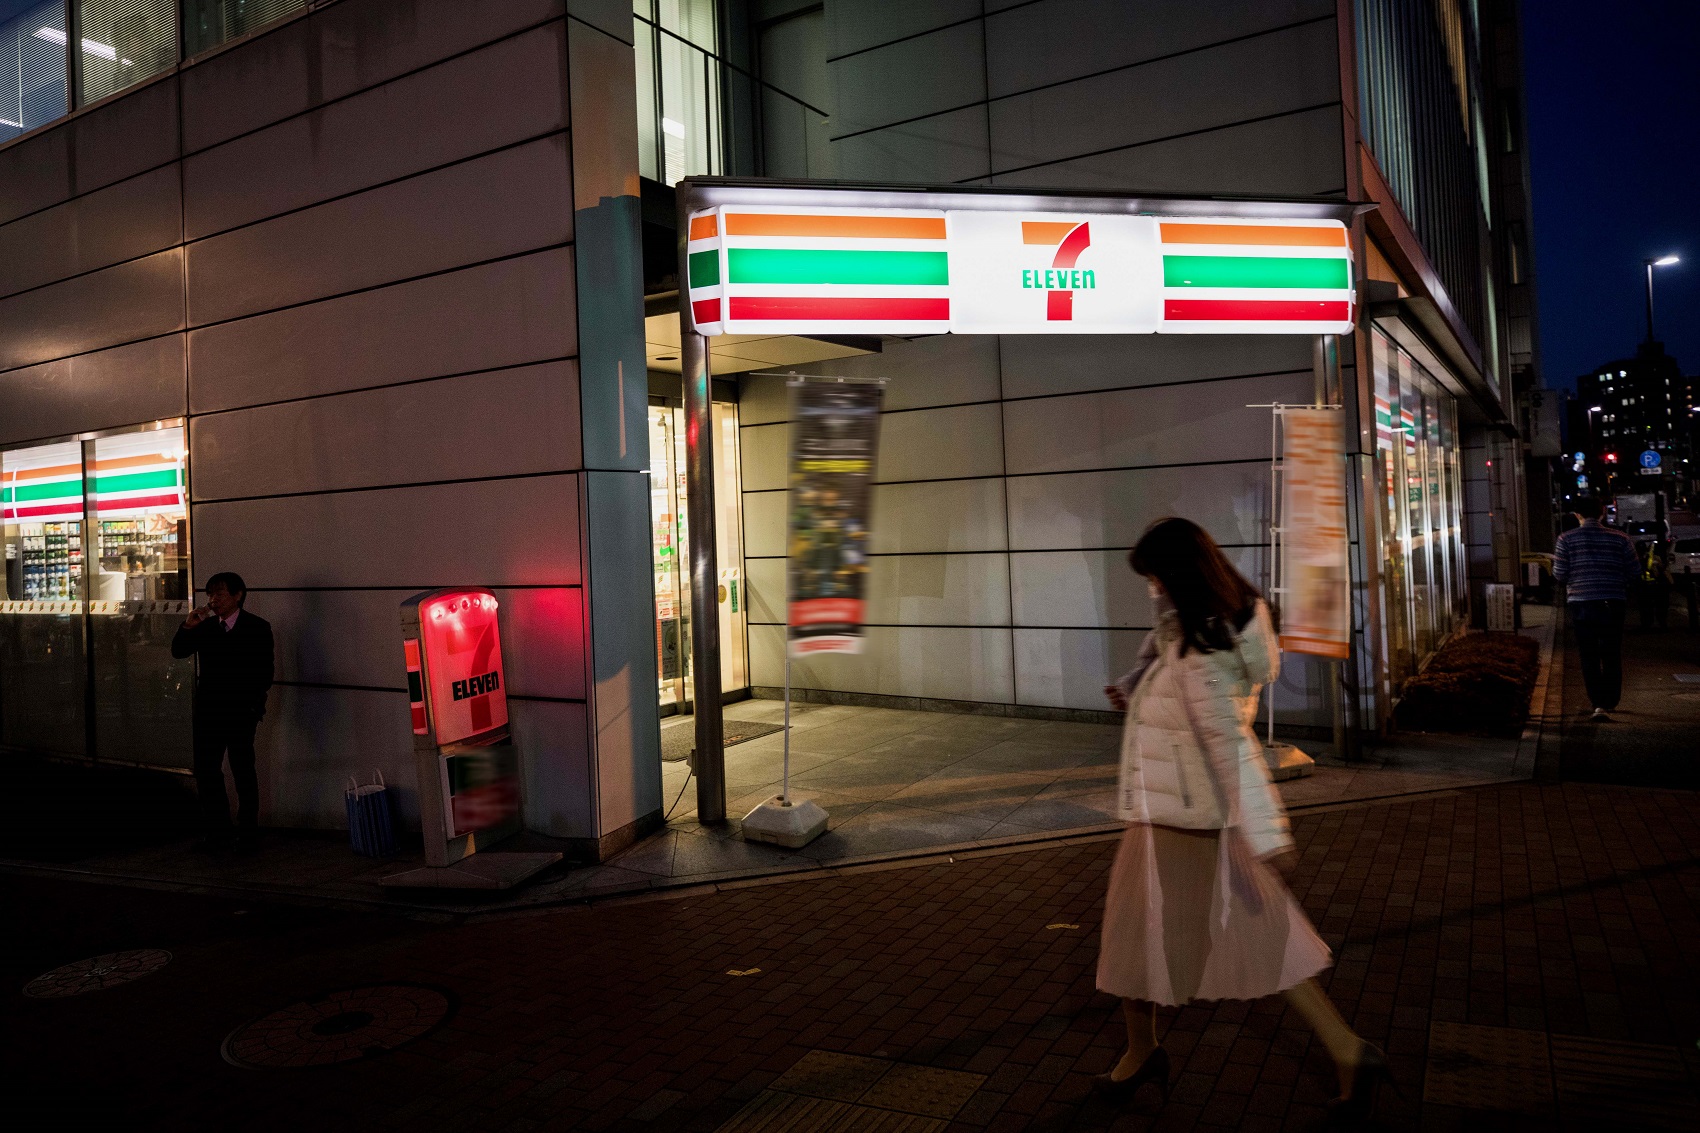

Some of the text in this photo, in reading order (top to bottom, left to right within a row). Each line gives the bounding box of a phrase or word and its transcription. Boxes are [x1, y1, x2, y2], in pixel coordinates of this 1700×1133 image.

[1021, 221, 1091, 321] 7
[1644, 454, 1653, 467] P
[446, 621, 496, 732] 7
